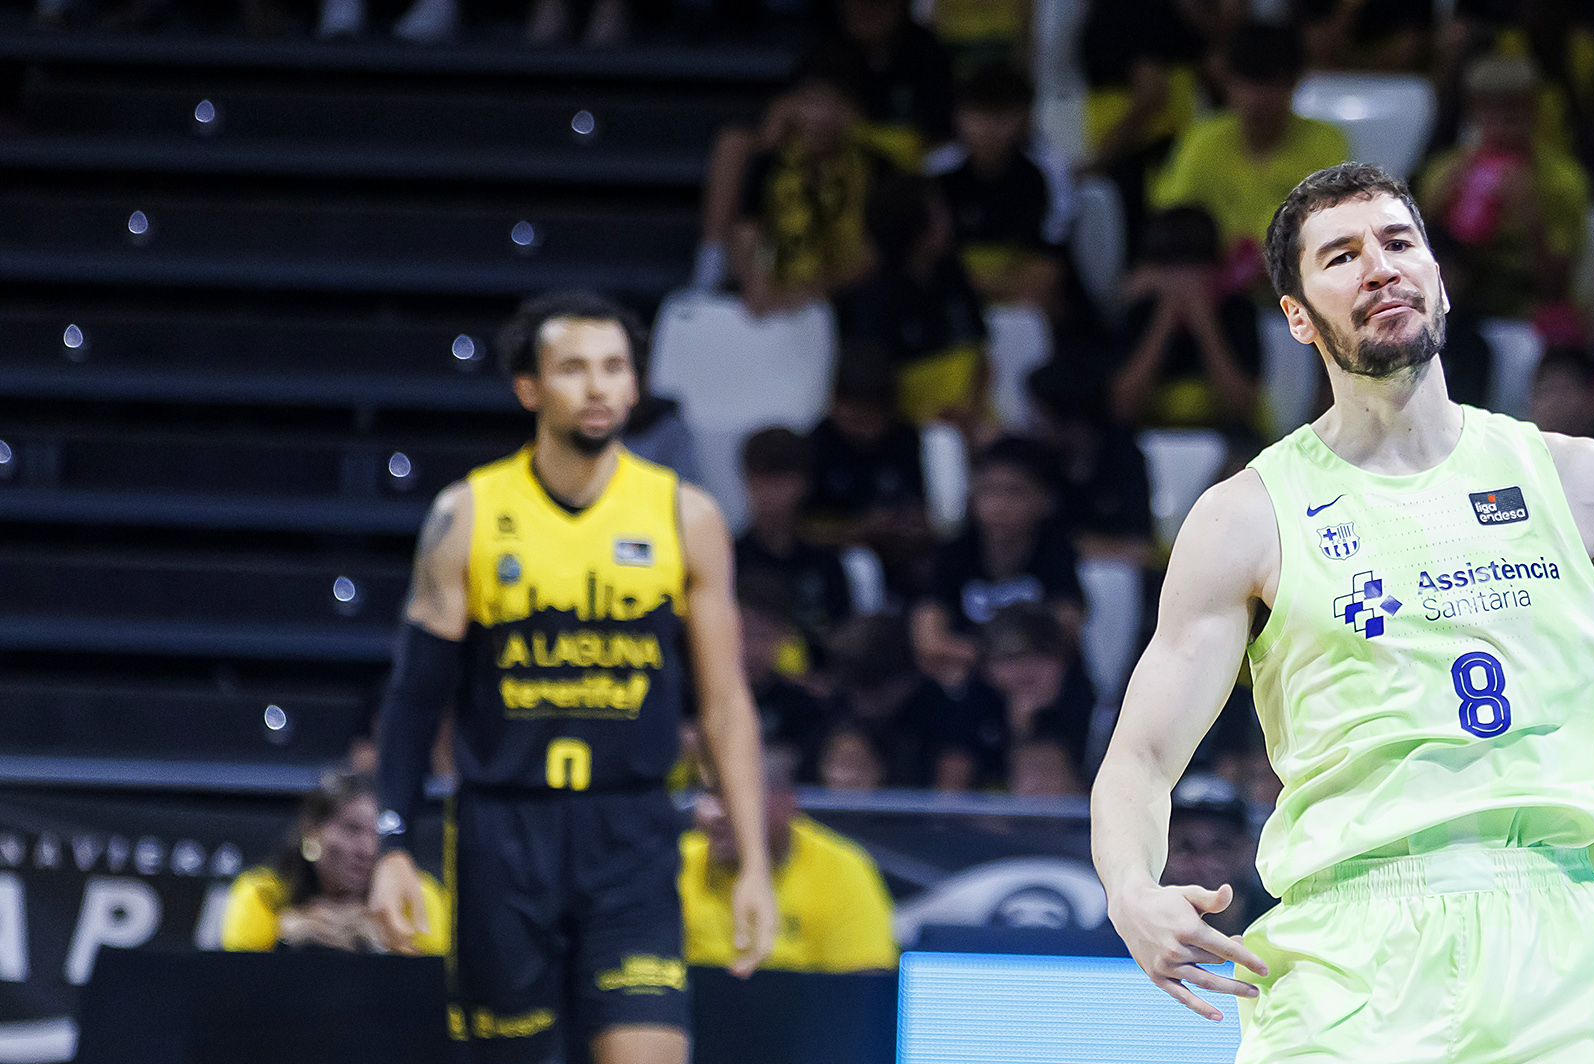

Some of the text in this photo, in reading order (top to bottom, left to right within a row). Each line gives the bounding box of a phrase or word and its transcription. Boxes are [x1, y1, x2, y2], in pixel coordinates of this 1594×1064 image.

[1475, 502, 1497, 514] liga
[1480, 509, 1526, 523] endesa
[1417, 556, 1561, 595] Assistència
[1423, 585, 1532, 622] Sanitària
[1451, 651, 1512, 739] 8
